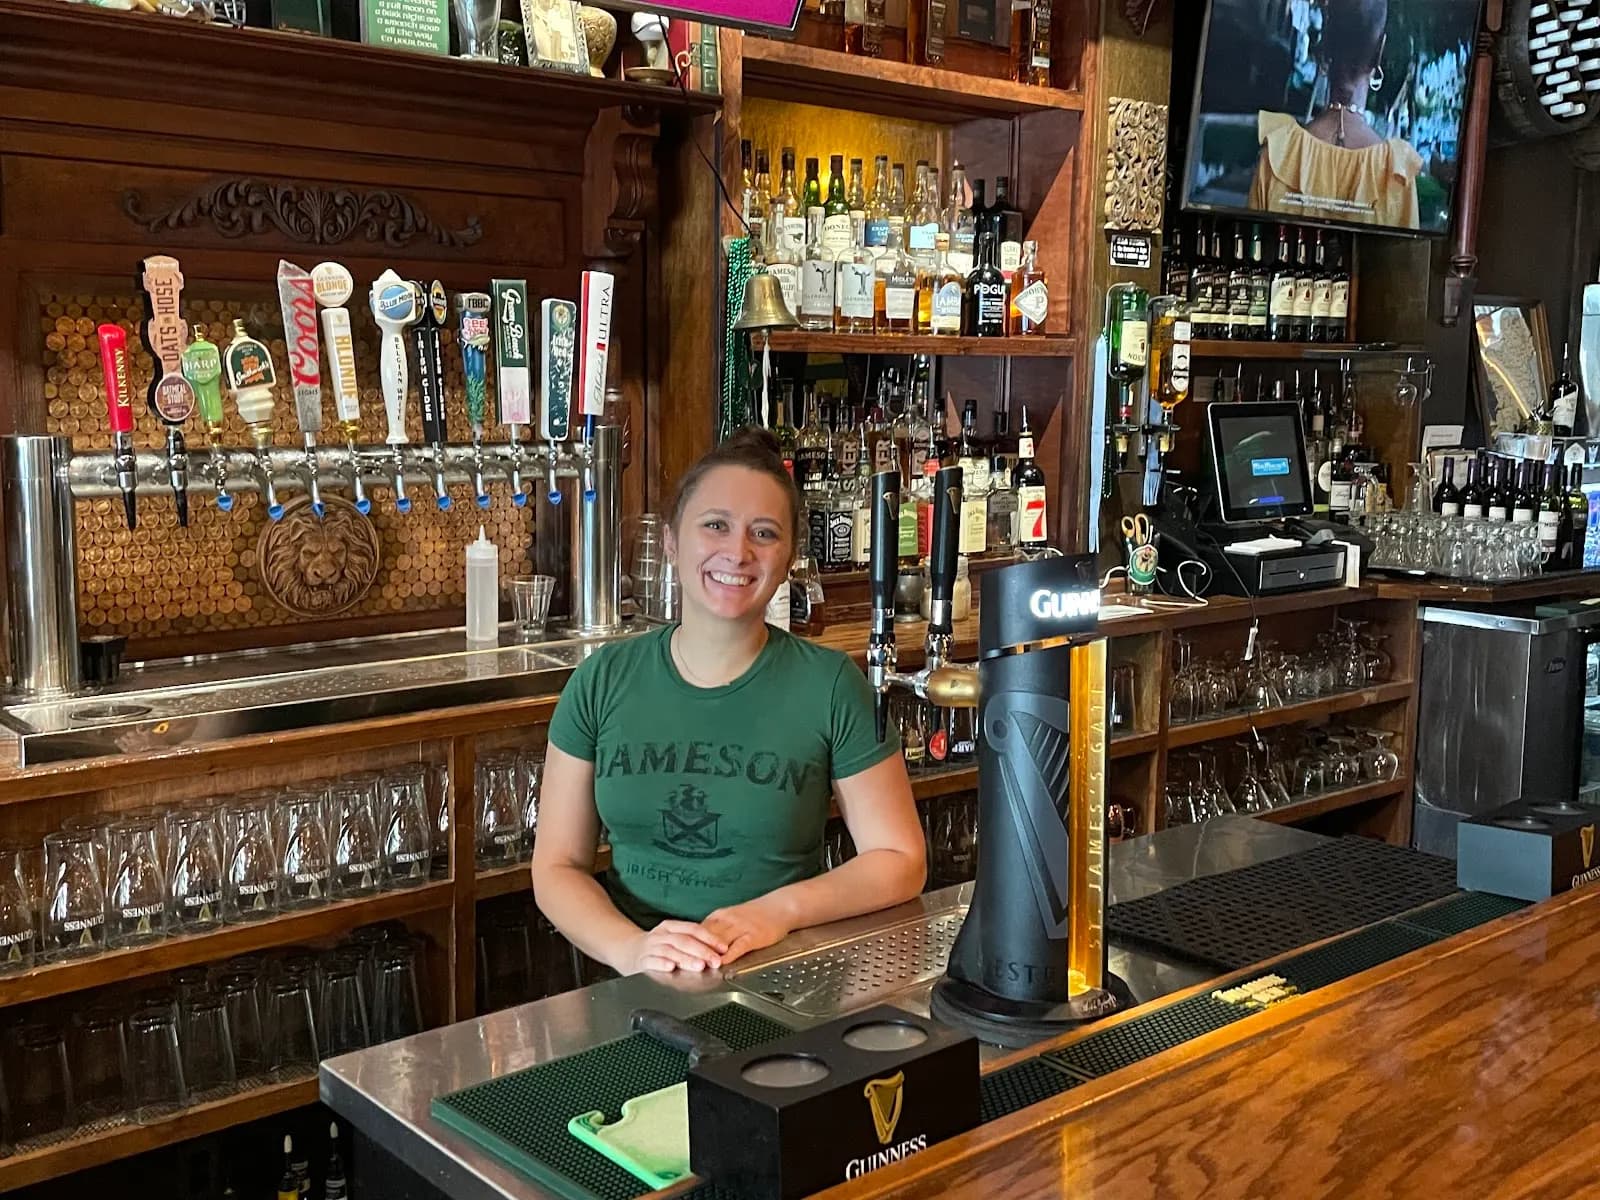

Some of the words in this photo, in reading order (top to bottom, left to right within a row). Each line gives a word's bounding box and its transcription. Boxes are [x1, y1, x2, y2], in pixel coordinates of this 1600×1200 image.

[402, 4, 425, 13] moon
[397, 28, 413, 36] the
[414, 32, 433, 41] way
[316, 279, 349, 293] BLONDE
[155, 278, 176, 315] HOSE
[380, 299, 398, 310] BLUE
[398, 292, 414, 303] MOON
[468, 298, 489, 309] TBBC
[598, 286, 612, 340] ULTRA
[288, 278, 320, 388] Coors
[160, 325, 180, 362] OATS
[417, 331, 428, 375] IRISH
[184, 359, 217, 371] HARP
[394, 336, 404, 385] BELGIAN
[114, 350, 130, 408] KILKENNY
[421, 378, 433, 421] CIDER
[1026, 501, 1045, 537] 7
[596, 740, 809, 796] JAMESON
[1088, 770, 1104, 892] JAMES'S
[396, 849, 430, 864] GUINNESS
[626, 863, 670, 883] IRISH
[240, 880, 278, 896] GUINNESS
[184, 890, 223, 907] GUINNESS
[122, 901, 165, 919] GUINNESS
[64, 913, 105, 932] GUINNESS
[0, 928, 34, 946] GUINNE
[845, 1132, 928, 1182] GUINNESS
